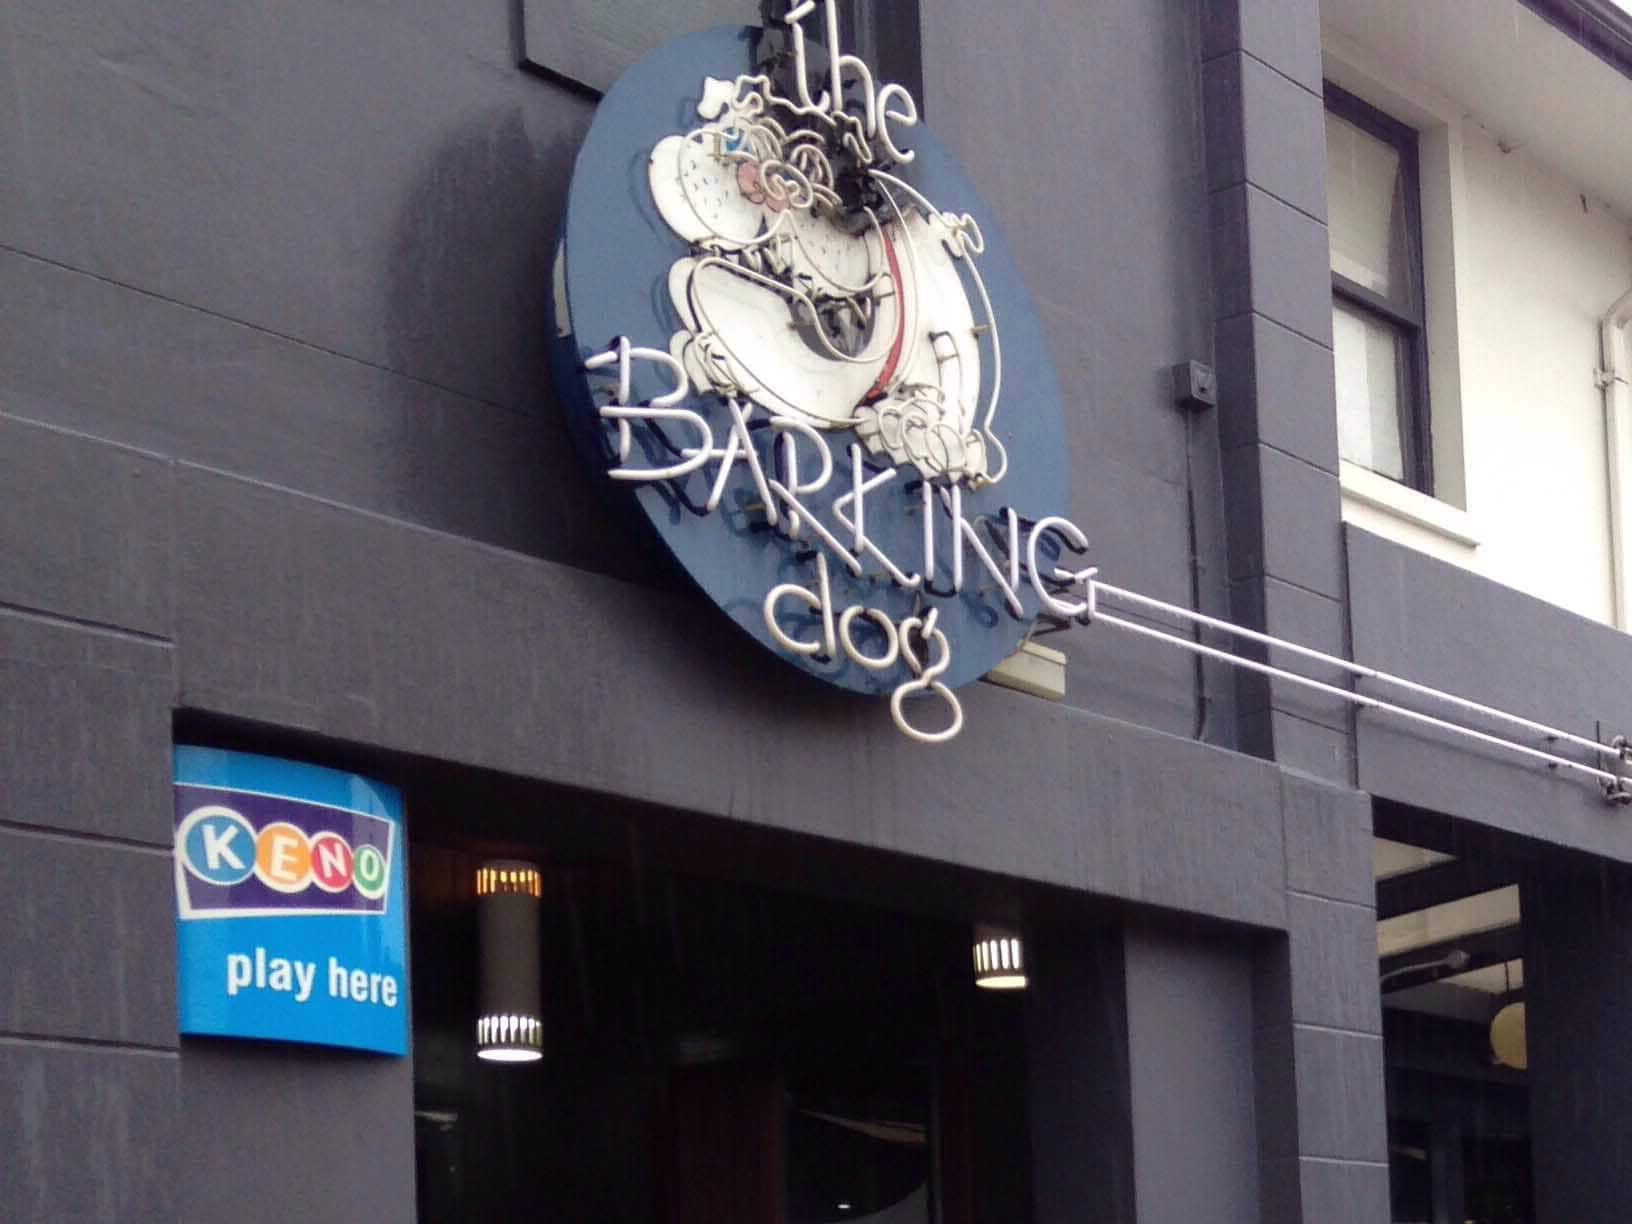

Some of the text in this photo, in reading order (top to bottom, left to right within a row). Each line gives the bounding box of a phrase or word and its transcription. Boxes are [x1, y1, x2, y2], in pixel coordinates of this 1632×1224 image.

[785, 0, 918, 162] the
[584, 335, 1098, 619] BARKING
[763, 551, 963, 744] dog
[200, 821, 382, 882] KENO
[226, 947, 399, 1009] play here
